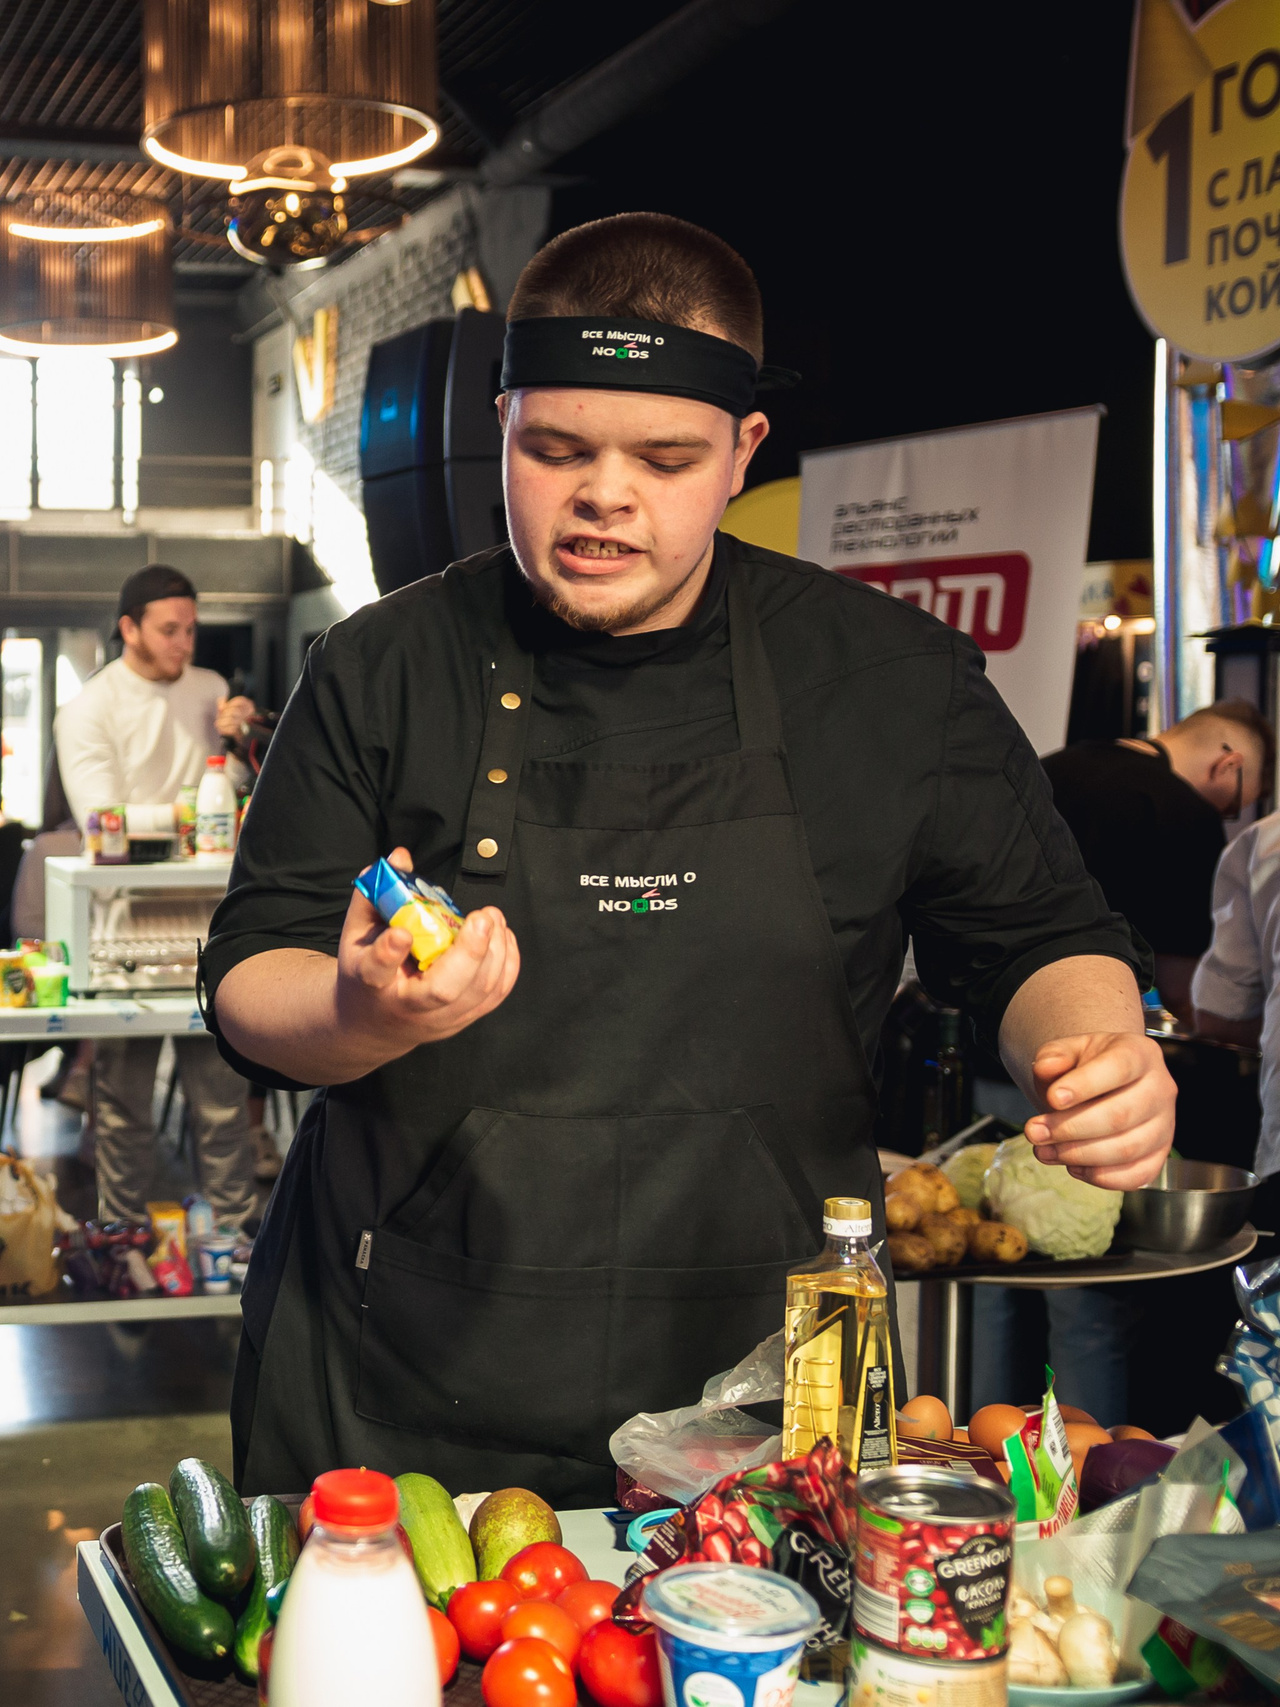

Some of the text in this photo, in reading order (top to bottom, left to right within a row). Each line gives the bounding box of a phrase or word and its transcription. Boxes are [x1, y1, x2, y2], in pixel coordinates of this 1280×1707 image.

[1145, 92, 1195, 266] 1
[1207, 168, 1230, 209] С
[581, 330, 604, 339] ВСЕ
[606, 330, 651, 343] МЫСЛИ
[592, 346, 650, 359] NOODS
[580, 871, 697, 888] ВСЕ МЫСЛИ О
[598, 898, 678, 913] NOODS
[789, 1531, 851, 1602] GREE
